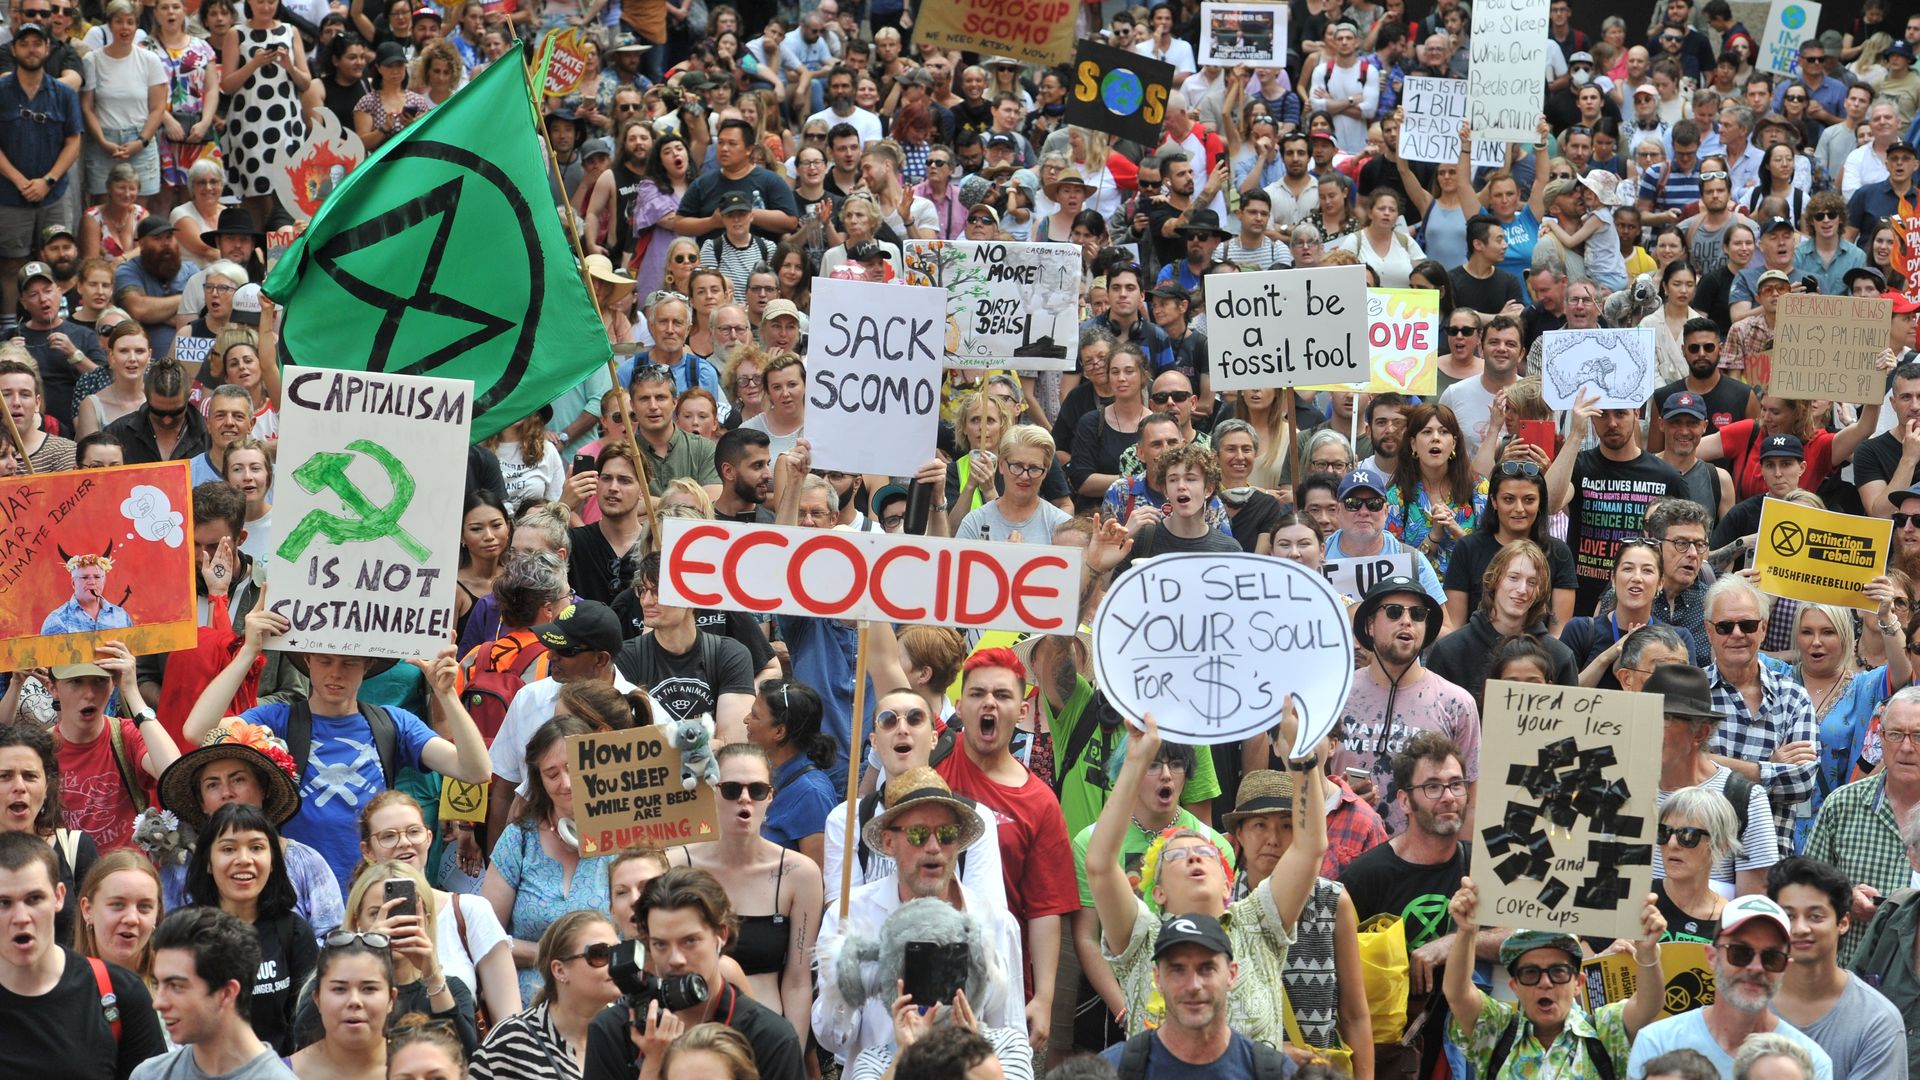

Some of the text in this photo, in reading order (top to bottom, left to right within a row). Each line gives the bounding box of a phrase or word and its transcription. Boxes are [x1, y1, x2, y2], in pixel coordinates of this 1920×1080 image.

[963, 13, 1049, 45] SCOMO
[1473, 15, 1547, 35] We Sleep
[925, 31, 939, 40] WE
[946, 34, 974, 45] NEED
[980, 39, 1012, 52] ACTION
[1407, 79, 1467, 96] THIS IS FO
[1470, 70, 1507, 96] Beds
[1407, 94, 1424, 114] 1
[1405, 117, 1451, 134] DEAD
[974, 244, 1006, 264] NO
[988, 264, 1037, 285] MORE
[976, 299, 1020, 317] DIRTY
[1214, 283, 1283, 319] don't
[1306, 280, 1345, 316] be
[1784, 297, 1885, 320] BREAKING NEWS
[825, 312, 936, 361] SACK
[976, 316, 1023, 335] DEALS
[1243, 326, 1263, 347] a
[1369, 322, 1429, 351] OVE
[1780, 323, 1800, 343] AN
[1853, 327, 1890, 348] FINALLY
[1218, 333, 1357, 378] fossil fool
[1779, 349, 1826, 368] ROLLED
[1833, 350, 1841, 368] 4
[811, 370, 934, 415] SCOMO
[1777, 371, 1849, 394] FAILURES
[288, 372, 465, 425] CAPITALISM
[1582, 477, 1666, 495] BLACK LIVES MATTER
[0, 485, 45, 536] IAR
[48, 478, 95, 525] DENIER
[1592, 501, 1622, 513] HUMAN
[1625, 503, 1632, 514] IS
[1582, 512, 1622, 528] SCIENCE
[1625, 516, 1635, 529] IS
[0, 526, 32, 567] IAR
[1580, 537, 1606, 557] LOVE
[1809, 531, 1863, 549] extinction
[1822, 550, 1873, 566] rebellion
[308, 555, 441, 598] IS NOT
[669, 525, 1068, 630] ECOCIDE
[1140, 573, 1181, 603] I'D
[1201, 565, 1311, 602] SELL
[270, 599, 450, 639] SUSTAINABLE!
[1112, 611, 1340, 655] YOUR SOUL
[1133, 664, 1180, 702] FOR
[663, 685, 678, 697] THE
[680, 685, 715, 706] ANIMALS
[1504, 688, 1603, 713] tired of
[1517, 714, 1622, 735] your lies
[579, 739, 662, 770] HOW DO
[583, 767, 669, 798] YOU SLEEP
[585, 789, 697, 818] WHILE OUR BEDS
[634, 806, 662, 821] ARE
[600, 818, 692, 851] BURNING
[1555, 856, 1586, 871] and
